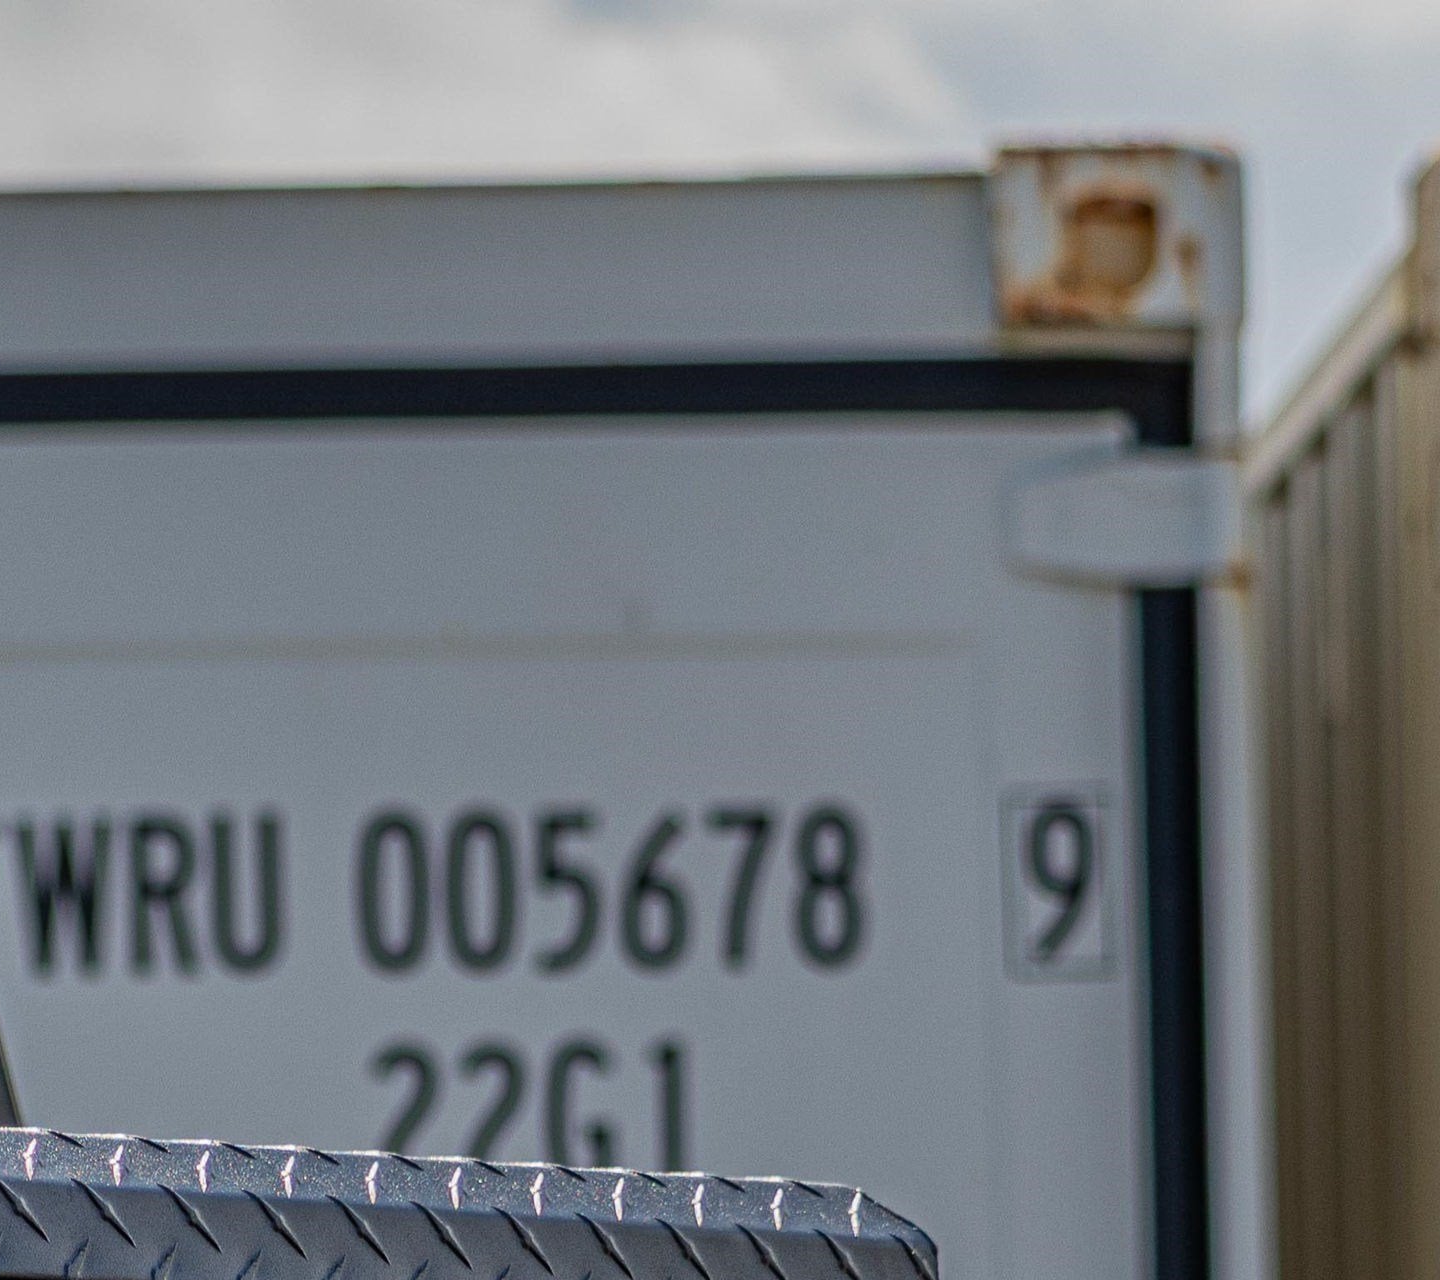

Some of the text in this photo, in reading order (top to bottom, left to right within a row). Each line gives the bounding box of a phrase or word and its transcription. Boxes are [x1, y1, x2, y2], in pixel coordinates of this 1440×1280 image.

[354, 804, 866, 974] 005678
[1029, 798, 1094, 964] 9
[370, 1034, 692, 1172] 22G1
